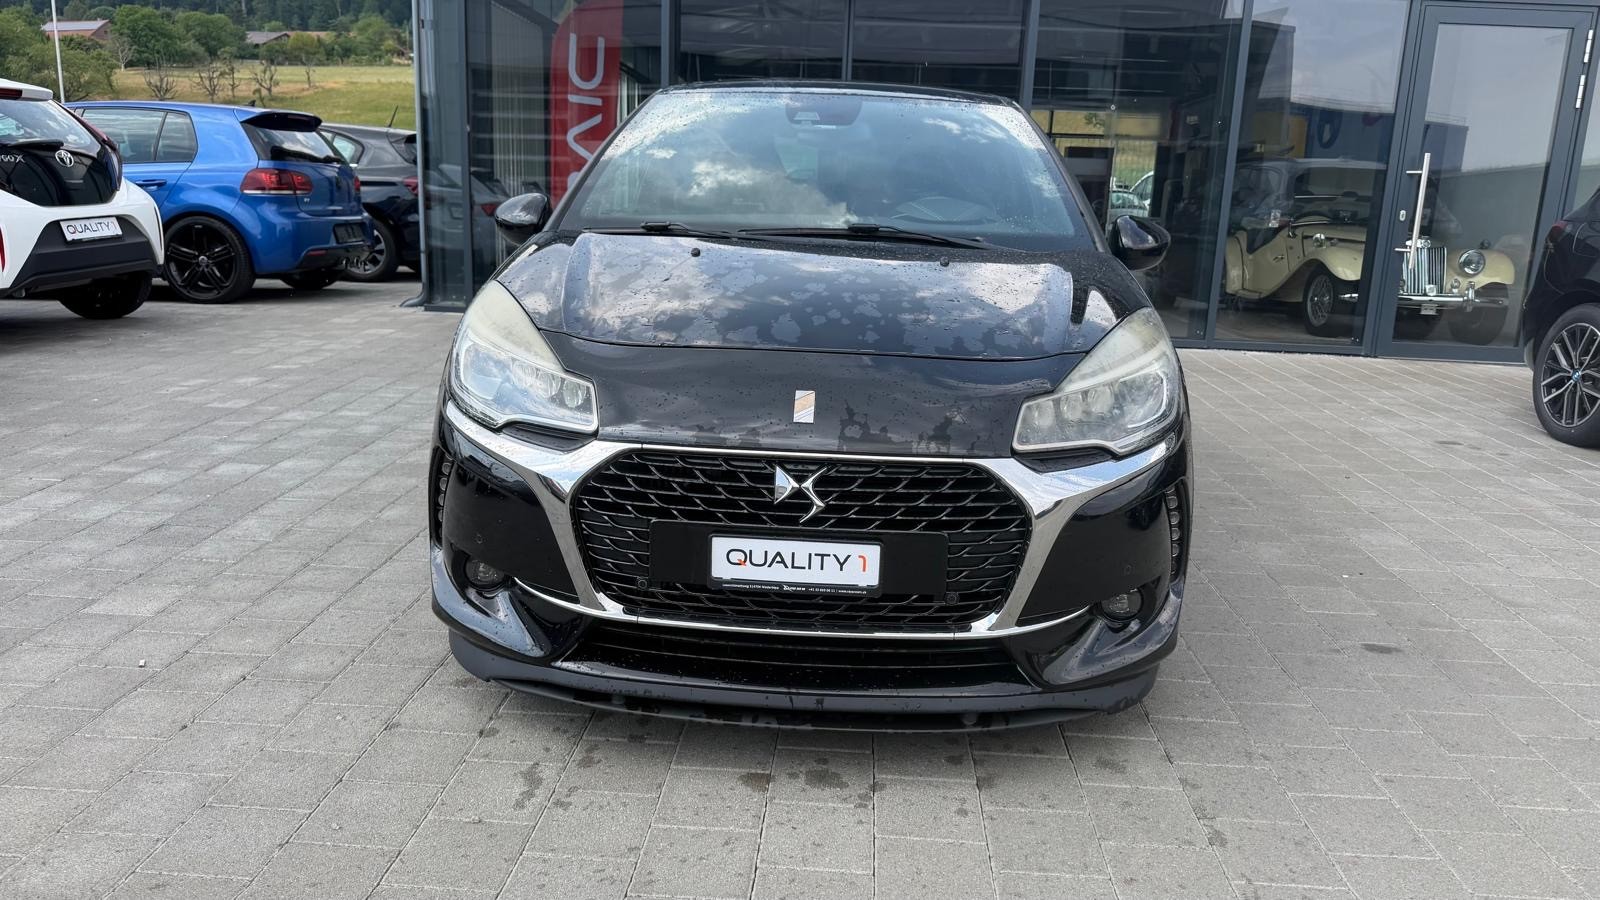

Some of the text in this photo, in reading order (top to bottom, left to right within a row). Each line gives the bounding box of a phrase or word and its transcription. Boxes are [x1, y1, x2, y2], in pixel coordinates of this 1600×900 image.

[66, 221, 110, 235] QUALITY
[725, 548, 868, 573] QUALITY 1
